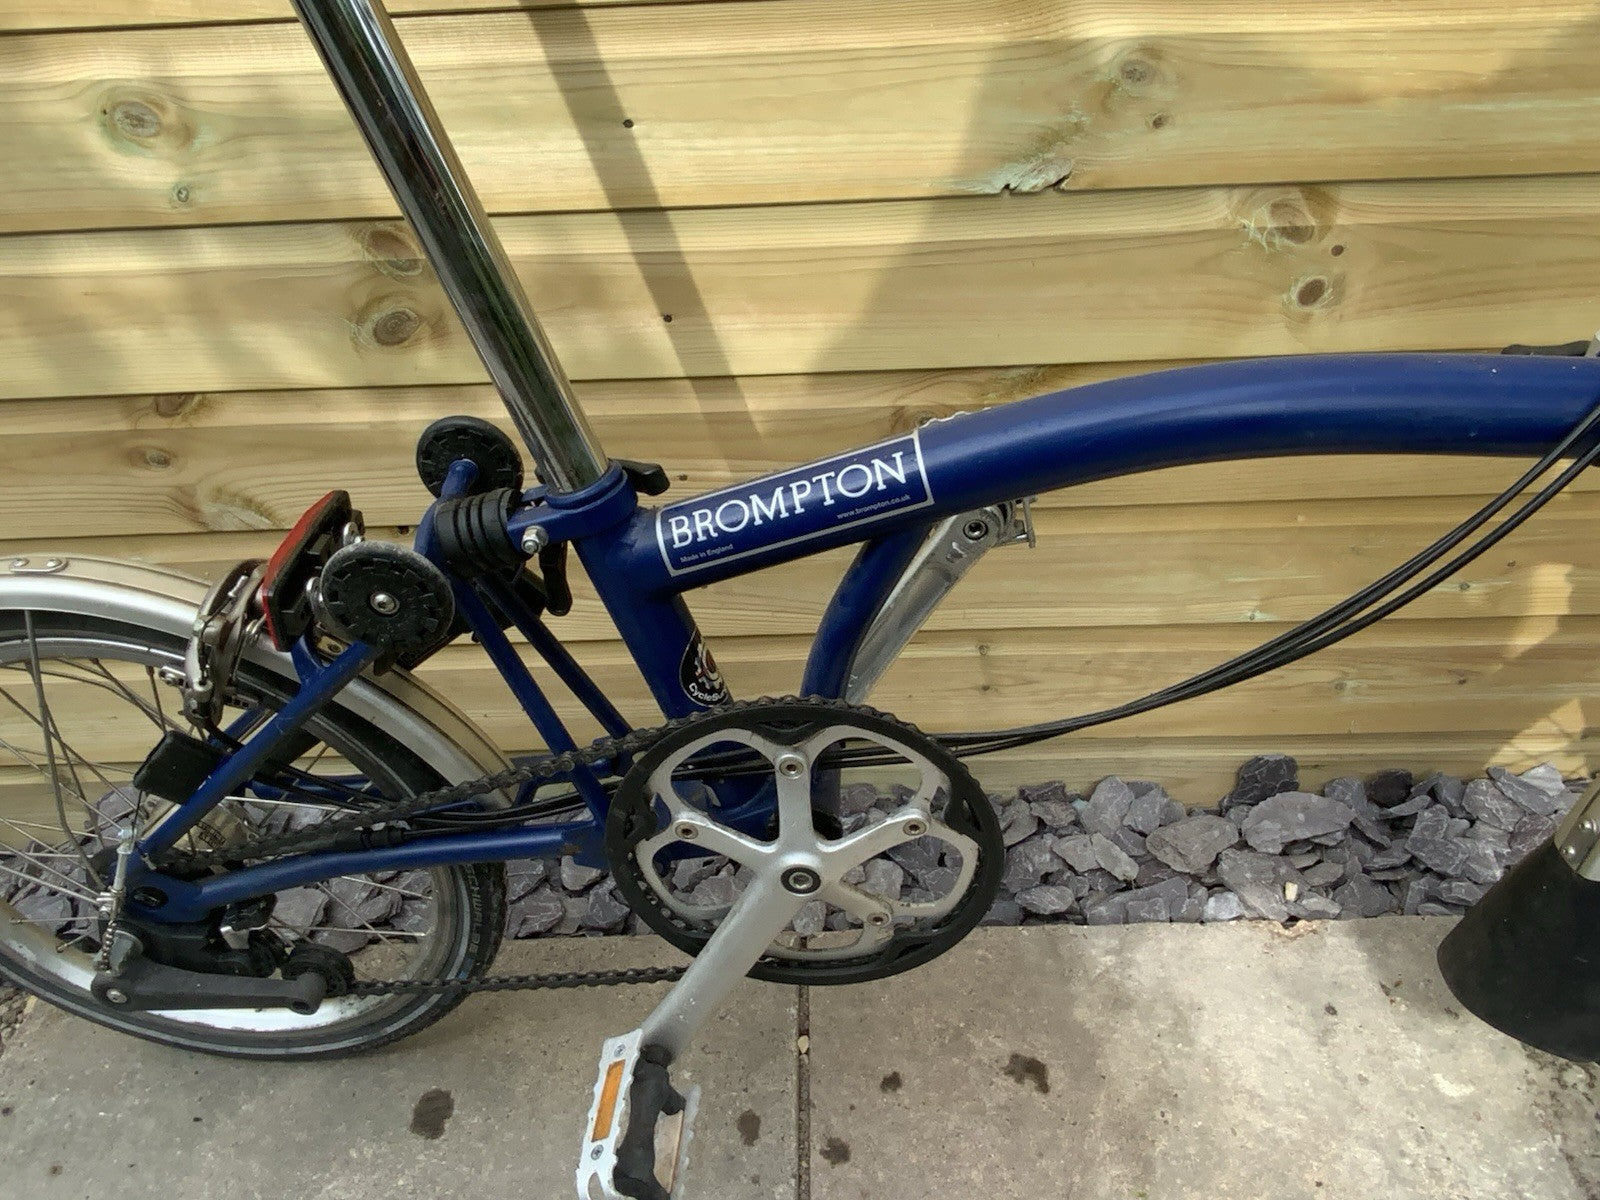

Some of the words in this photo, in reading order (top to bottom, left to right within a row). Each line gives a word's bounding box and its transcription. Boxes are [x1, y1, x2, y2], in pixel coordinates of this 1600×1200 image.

[668, 451, 906, 549] BROMPTON
[836, 494, 911, 519] www.brompton.co.uk
[680, 553, 699, 563] Made
[706, 543, 734, 556] England
